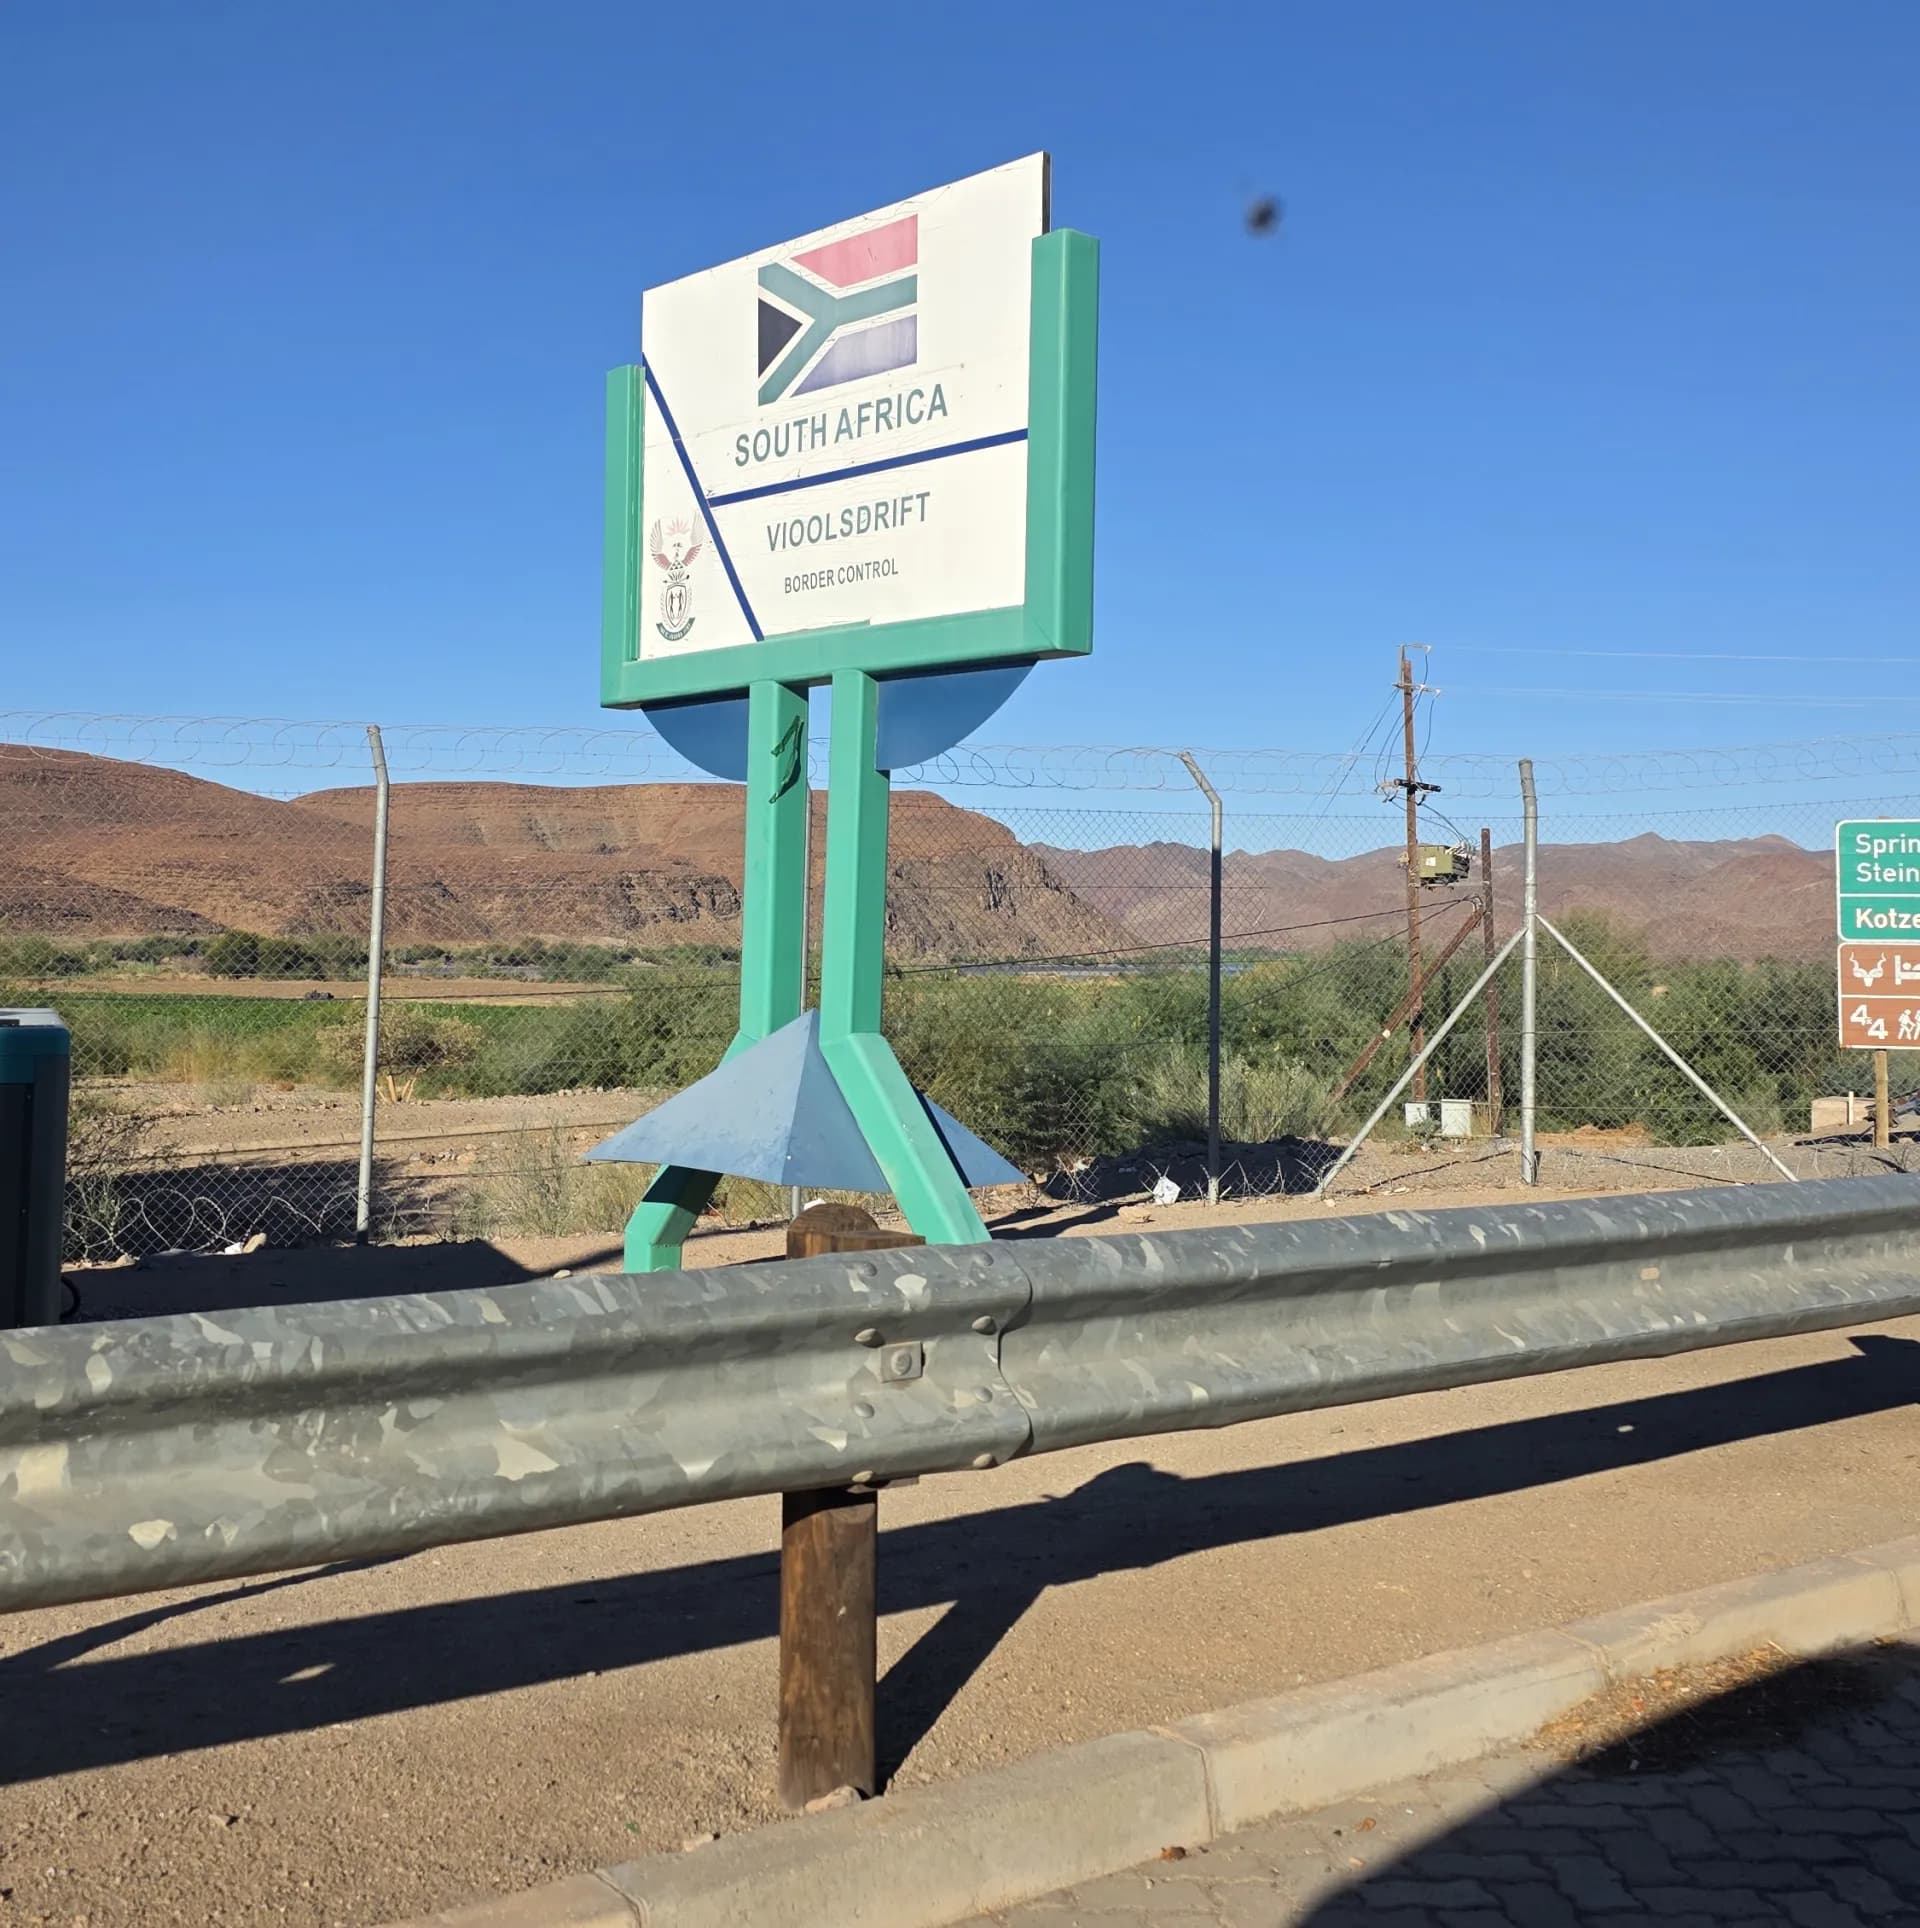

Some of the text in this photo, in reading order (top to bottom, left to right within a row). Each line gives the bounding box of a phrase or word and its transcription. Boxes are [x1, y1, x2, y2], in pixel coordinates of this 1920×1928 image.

[735, 383, 948, 467] SOUTH AFRICA
[767, 491, 930, 552] VIOOLSDRIFT
[784, 558, 899, 594] BORDER CONTROL
[1855, 833, 1920, 859] Sprin
[1856, 862, 1920, 883] Stein
